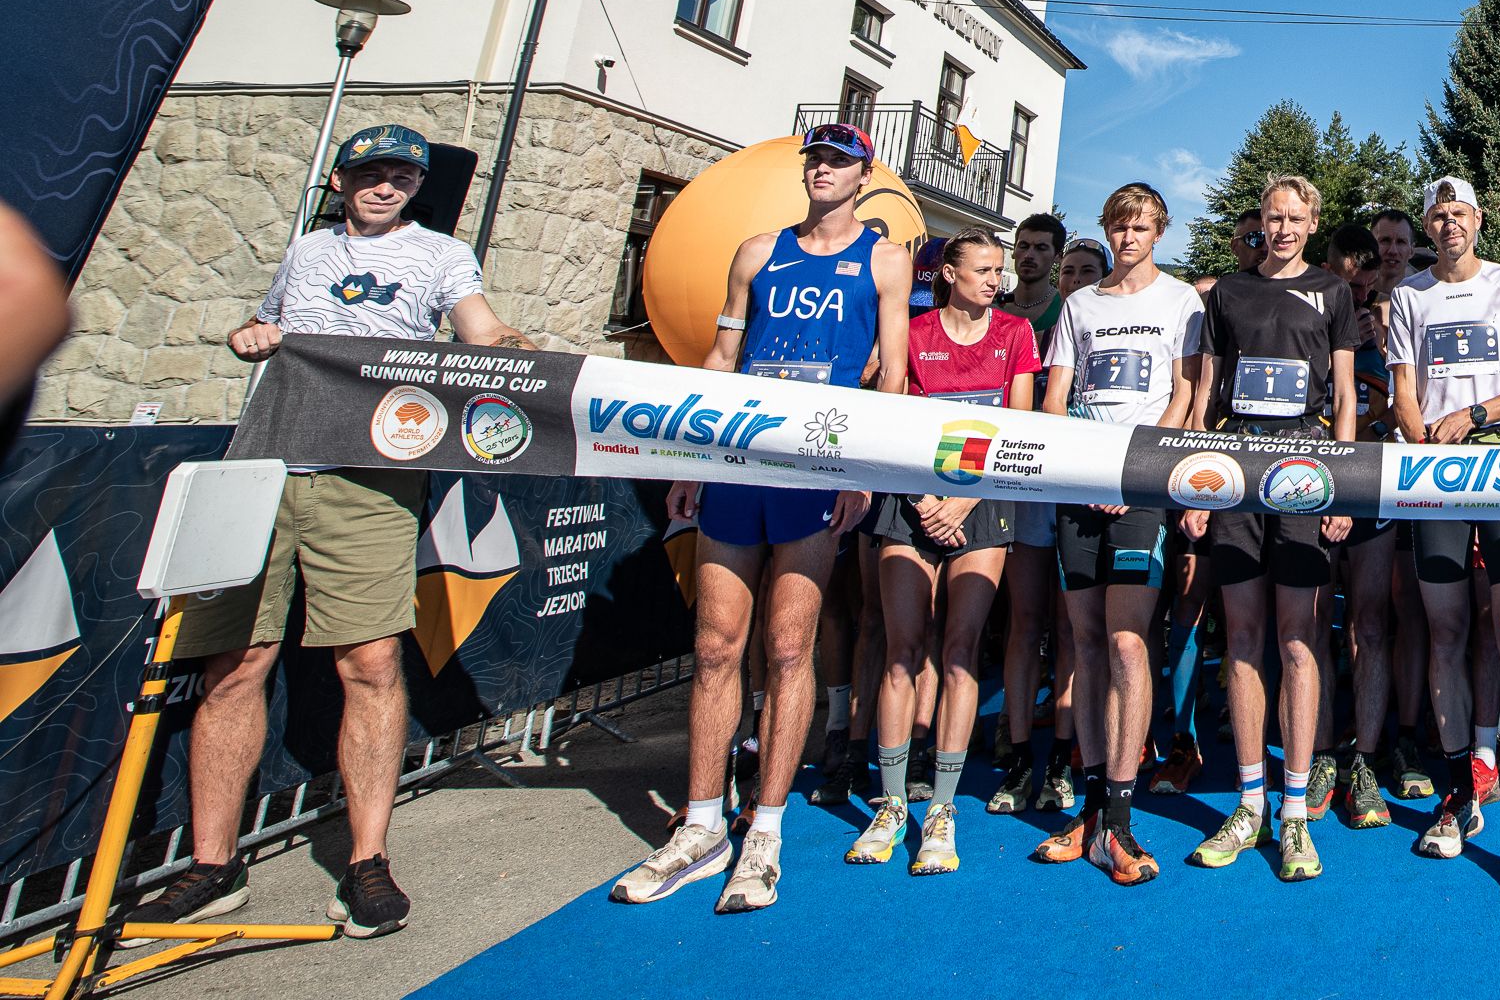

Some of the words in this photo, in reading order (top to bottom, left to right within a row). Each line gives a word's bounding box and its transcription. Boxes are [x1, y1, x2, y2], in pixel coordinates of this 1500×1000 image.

[767, 286, 844, 322] USA
[1096, 326, 1162, 337] SCARPA
[1457, 339, 1469, 356] 5
[382, 350, 437, 366] WMRA
[440, 353, 535, 374] MOUNTAIN
[360, 364, 437, 384] RUNNING
[441, 372, 505, 390] WORLD
[508, 377, 547, 393] CUP
[1109, 366, 1121, 382] 7
[1266, 377, 1275, 394] 1
[588, 393, 787, 450] valsir
[593, 442, 640, 455] fondital
[1001, 439, 1045, 450] Turismo
[1158, 436, 1241, 451] RUNNING
[1248, 443, 1312, 455] WORLD
[1317, 446, 1356, 456] CUP
[1243, 435, 1336, 446] MOUNTAIN
[659, 449, 712, 461] RAFFMETAL
[724, 454, 746, 465] OLI
[798, 447, 841, 459] SILMAR
[996, 450, 1034, 461] Centro
[993, 462, 1042, 476] Portugal
[1396, 501, 1443, 509] fondital
[546, 503, 606, 528] FESTIWAL
[544, 530, 607, 557] MARATON
[547, 561, 589, 587] TRZECH
[537, 590, 586, 617] JEZIOR
